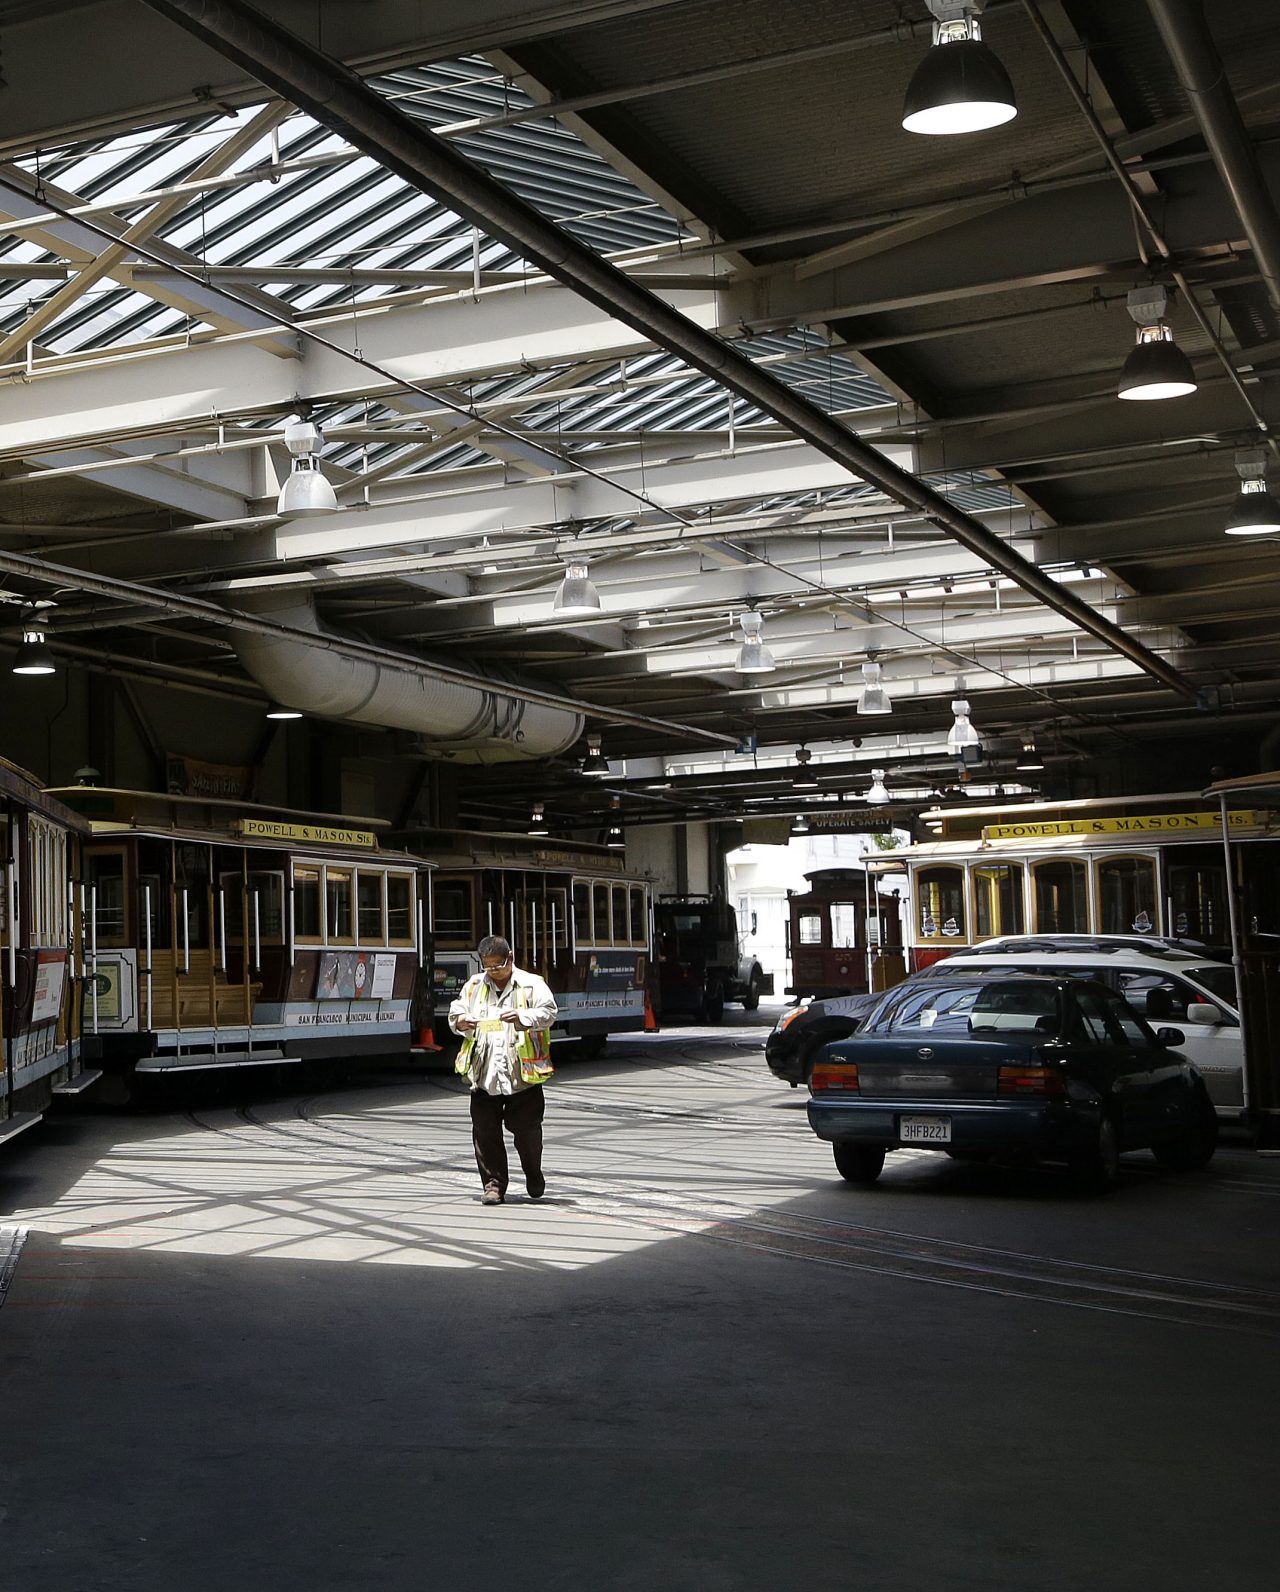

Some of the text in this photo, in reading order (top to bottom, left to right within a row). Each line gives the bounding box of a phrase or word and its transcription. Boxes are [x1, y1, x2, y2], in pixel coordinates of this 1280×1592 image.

[816, 819, 857, 828] OPERATE
[997, 812, 1248, 838] POWELL & MASON Sts.
[248, 822, 296, 837] POWELL
[302, 827, 310, 838] &
[314, 829, 353, 843] MASON
[298, 1015, 311, 1025] SAN
[904, 1125, 948, 1139] 3HFB221
